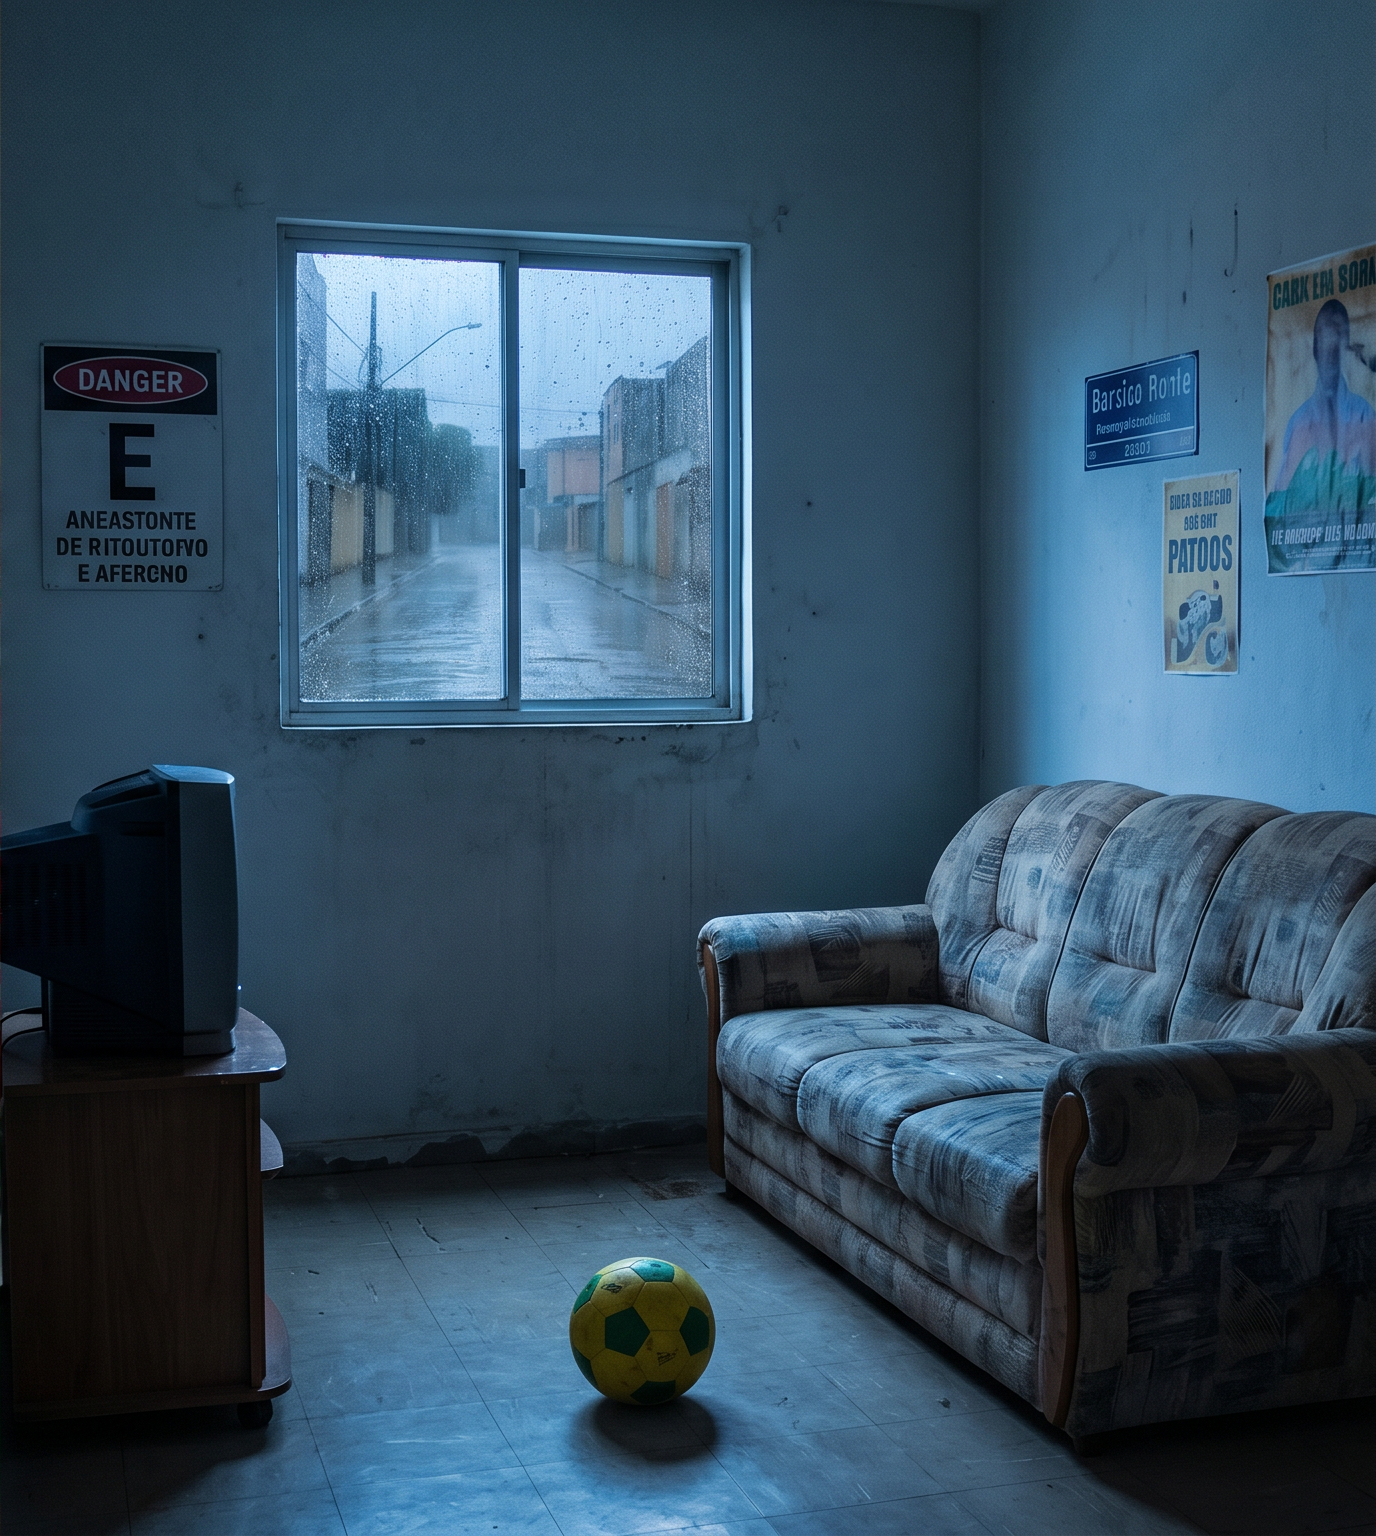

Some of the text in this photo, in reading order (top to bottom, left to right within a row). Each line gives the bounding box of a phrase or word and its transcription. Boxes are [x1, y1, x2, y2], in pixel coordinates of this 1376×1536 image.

[78, 368, 183, 394] DANGER
[109, 422, 156, 501] E
[66, 510, 196, 530] ANEASTONTE
[56, 537, 82, 556] DE
[1168, 534, 1233, 574] PATOOS
[78, 564, 90, 583] E
